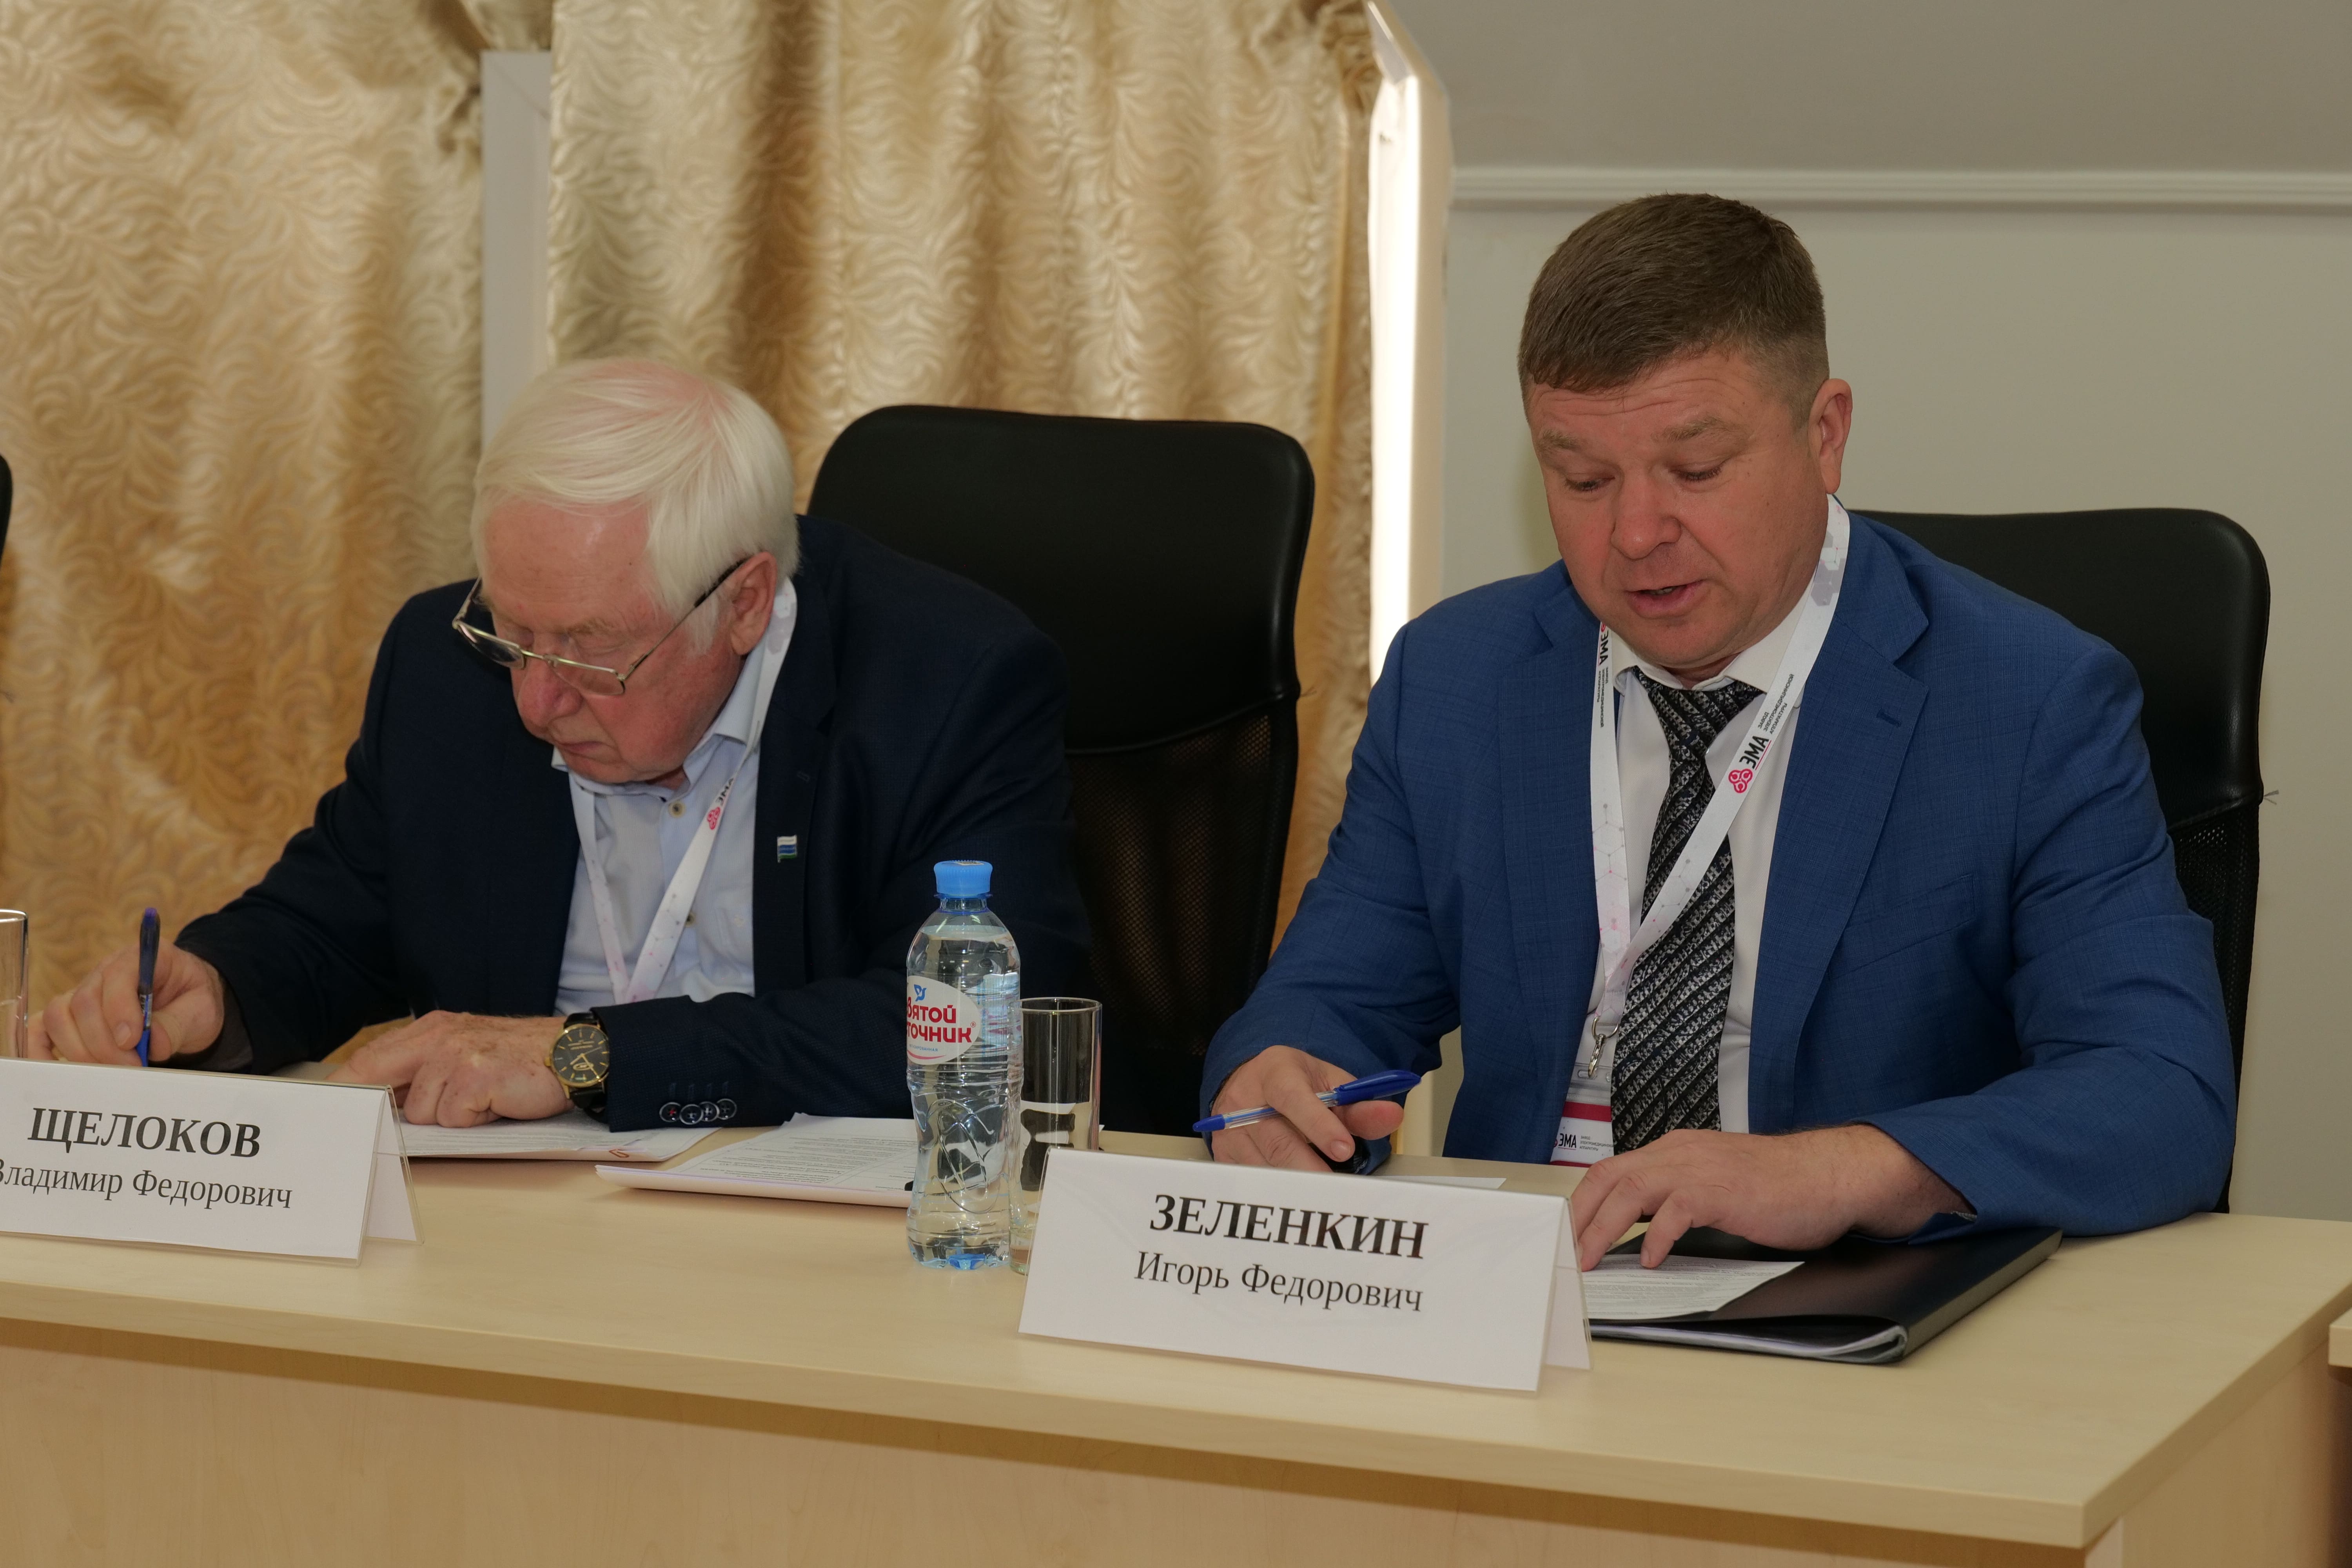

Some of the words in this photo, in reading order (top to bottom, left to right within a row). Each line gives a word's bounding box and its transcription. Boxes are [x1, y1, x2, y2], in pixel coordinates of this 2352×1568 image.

[1599, 630, 1609, 666] ЭМА
[1763, 673, 1794, 732] ЭЛЕКТРОМЕДИЦИНСКОЙ
[1769, 702, 1788, 734] АППАРАТУРЫ
[1758, 712, 1769, 729] ЗАВОД
[1739, 735, 1769, 769] ЭМА
[907, 996, 956, 1024] ВЯТОЙ
[907, 1021, 972, 1043] ТОЧНИК
[27, 1108, 261, 1158] ЩЕЛОКОВ
[1558, 1133, 1577, 1148] ЭМА
[133, 1170, 292, 1209] Федорович
[1149, 1194, 1429, 1259] ЗЕЛЕНКИН
[1135, 1251, 1229, 1295] Игорь
[1241, 1263, 1424, 1312] Федорович
